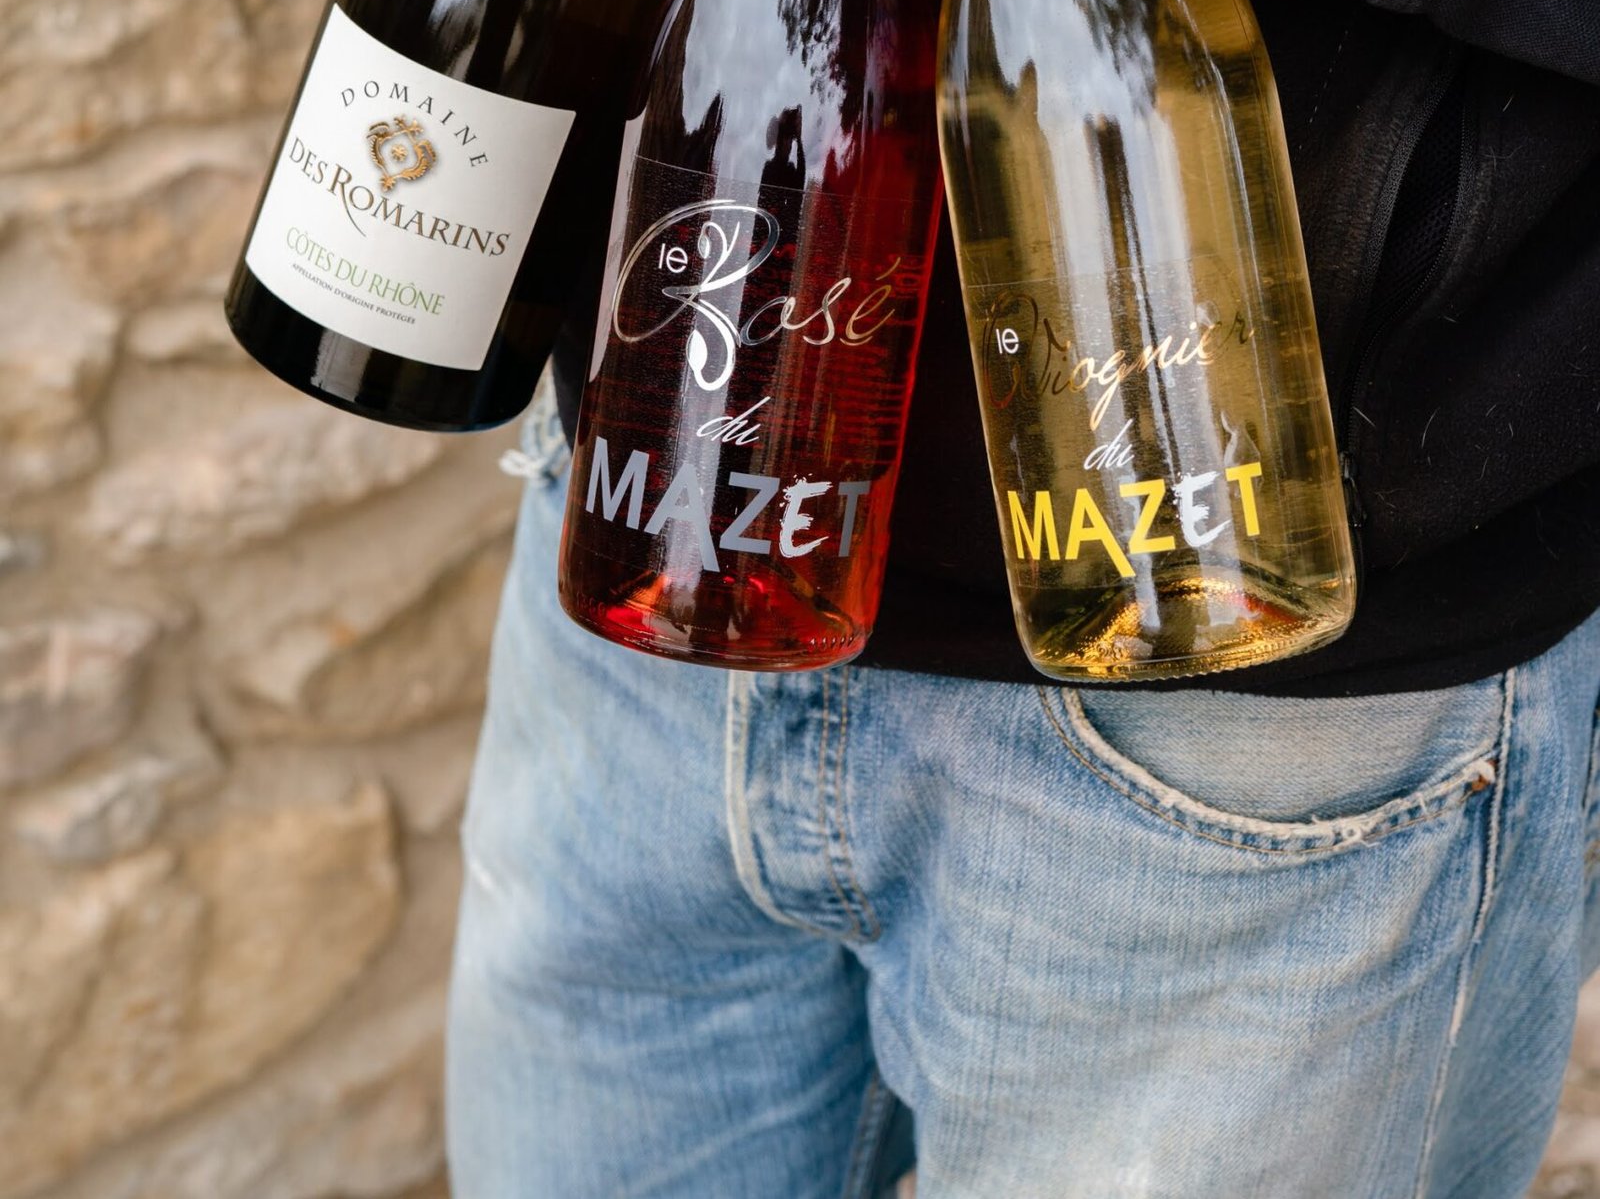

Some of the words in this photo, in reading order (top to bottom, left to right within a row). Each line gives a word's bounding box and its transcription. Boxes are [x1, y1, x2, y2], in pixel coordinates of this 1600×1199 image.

[340, 80, 489, 167] DOMAINE
[289, 137, 328, 185] DES
[326, 163, 511, 258] ROMARINS
[286, 226, 335, 273] CÔTES
[335, 257, 368, 288] DU
[368, 272, 446, 316] RHÔNE
[658, 243, 689, 274] le
[995, 327, 1020, 355] le
[696, 396, 771, 446] du
[1083, 418, 1136, 471] du
[585, 435, 871, 573] MAZET
[1007, 461, 1263, 578] MAZET
